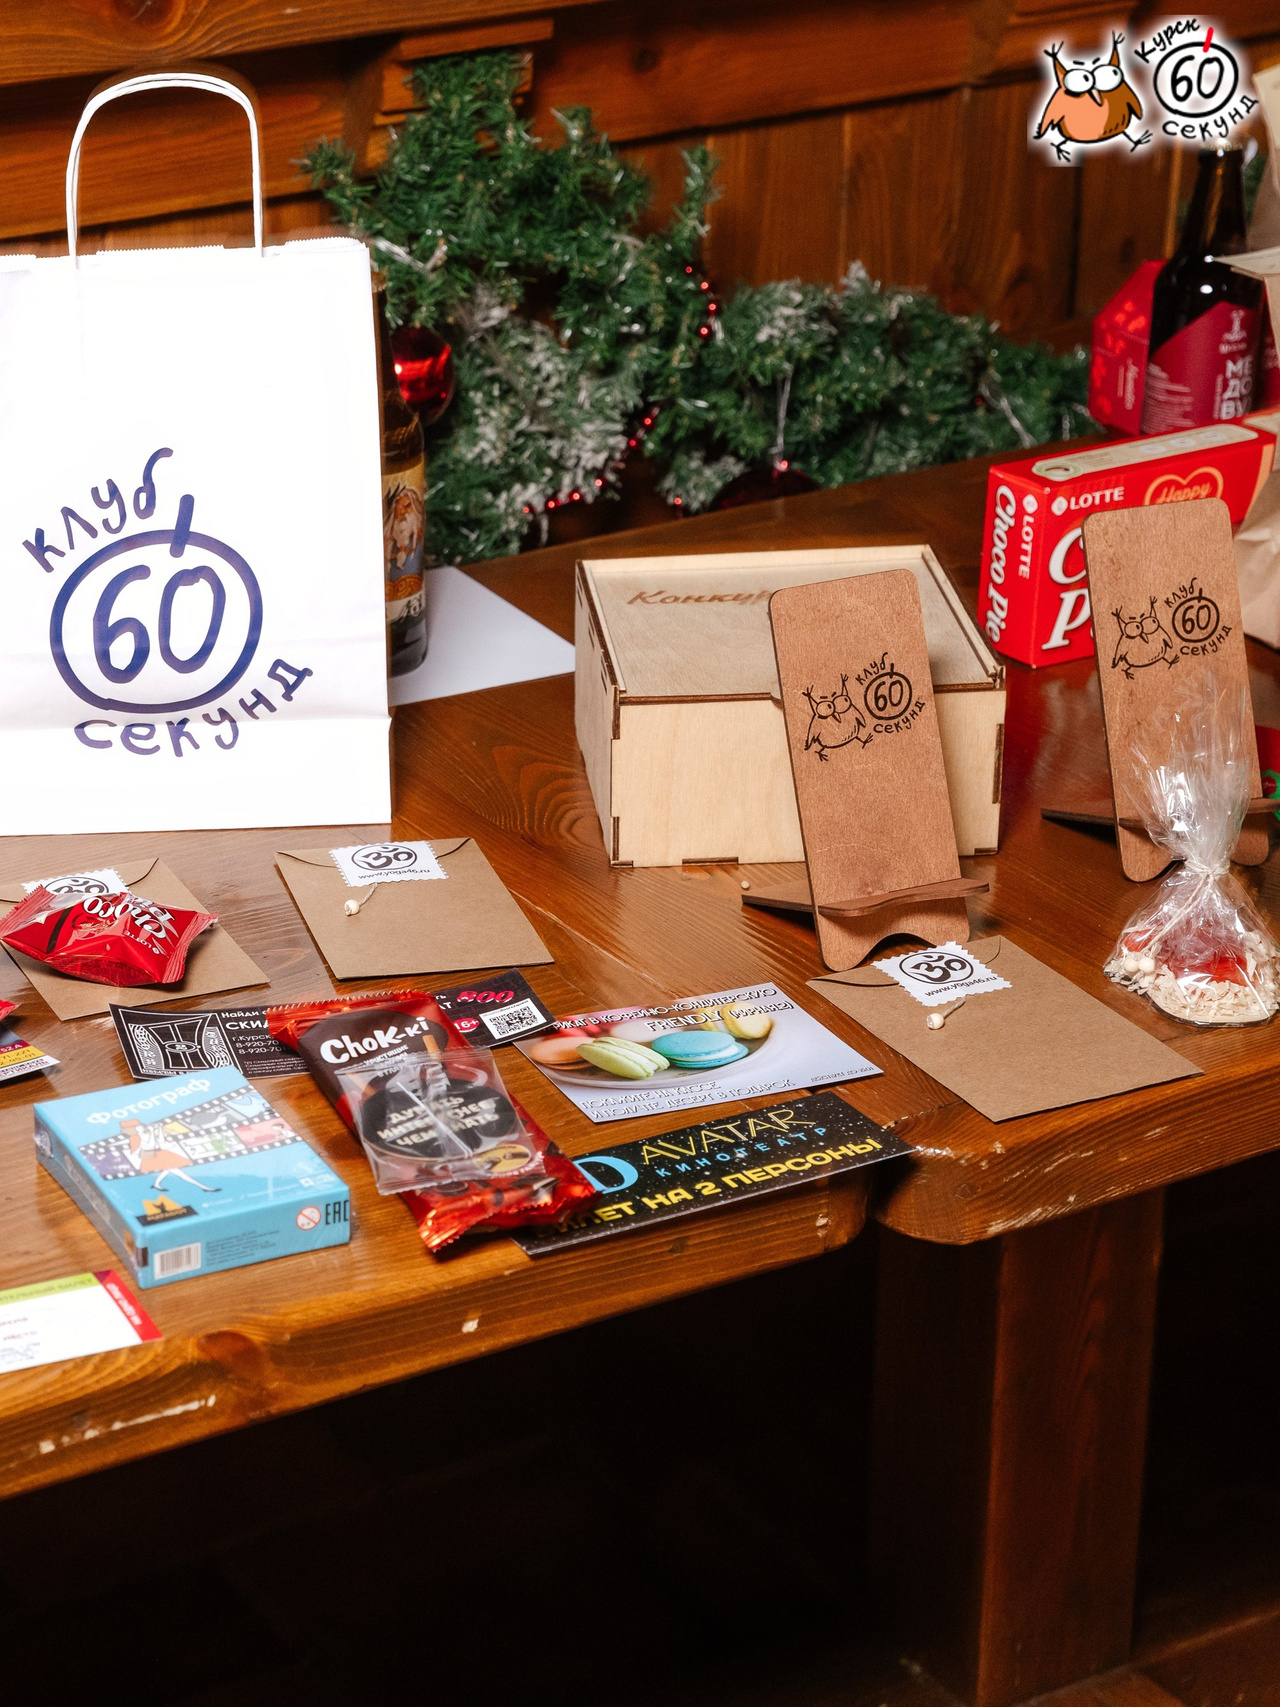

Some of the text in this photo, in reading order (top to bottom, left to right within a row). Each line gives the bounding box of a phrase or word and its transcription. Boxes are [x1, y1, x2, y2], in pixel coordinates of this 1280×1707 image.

[22, 447, 174, 573] клуб
[1070, 486, 1125, 511] LOTTE
[984, 485, 1017, 643] Choco Pie
[1018, 516, 1035, 579] LOTTE
[93, 564, 226, 684] 60
[1182, 604, 1211, 634] 60
[1180, 625, 1232, 656] секунд
[74, 658, 313, 757] секунд
[874, 679, 904, 712] 60
[873, 700, 926, 734] секунд
[358, 869, 431, 880] www.yoga46.ru
[83, 895, 169, 940] Choco
[456, 989, 515, 1004] 800
[925, 975, 998, 998] www.yoga46.ru
[221, 1010, 260, 1019] Найди
[453, 1018, 480, 1030] 16+
[642, 1009, 725, 1033] FRIENDLY
[86, 1077, 212, 1126] Фотограф
[641, 1108, 818, 1166] AVATAR
[655, 1127, 828, 1178] КИНОТЕАТР
[641, 1138, 884, 1212] НА 2 ПЕРСОНЫ
